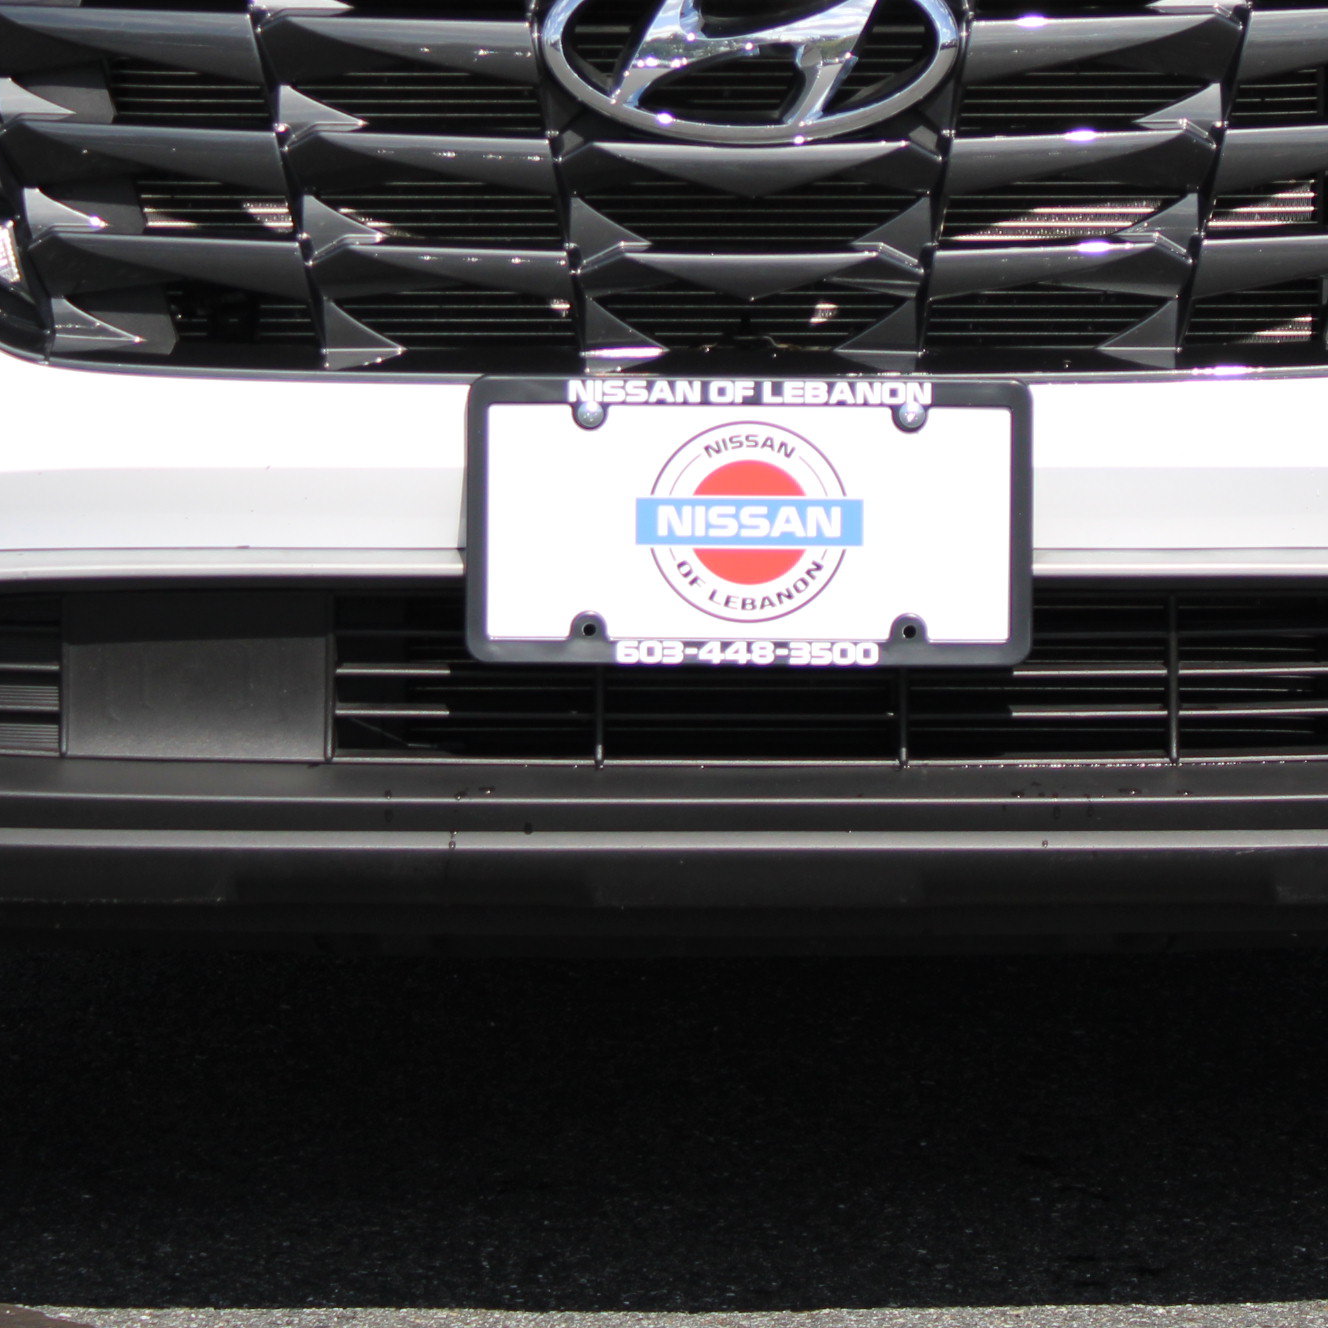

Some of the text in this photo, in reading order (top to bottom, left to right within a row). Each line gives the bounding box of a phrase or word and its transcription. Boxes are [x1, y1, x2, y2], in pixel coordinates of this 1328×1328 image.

[568, 380, 932, 406] NISSAN OF LEBANON
[704, 434, 796, 459] NISSAN
[657, 505, 841, 538] NISSAN
[676, 560, 824, 610] OF LEBANON
[616, 640, 879, 666] 603-448-3500
